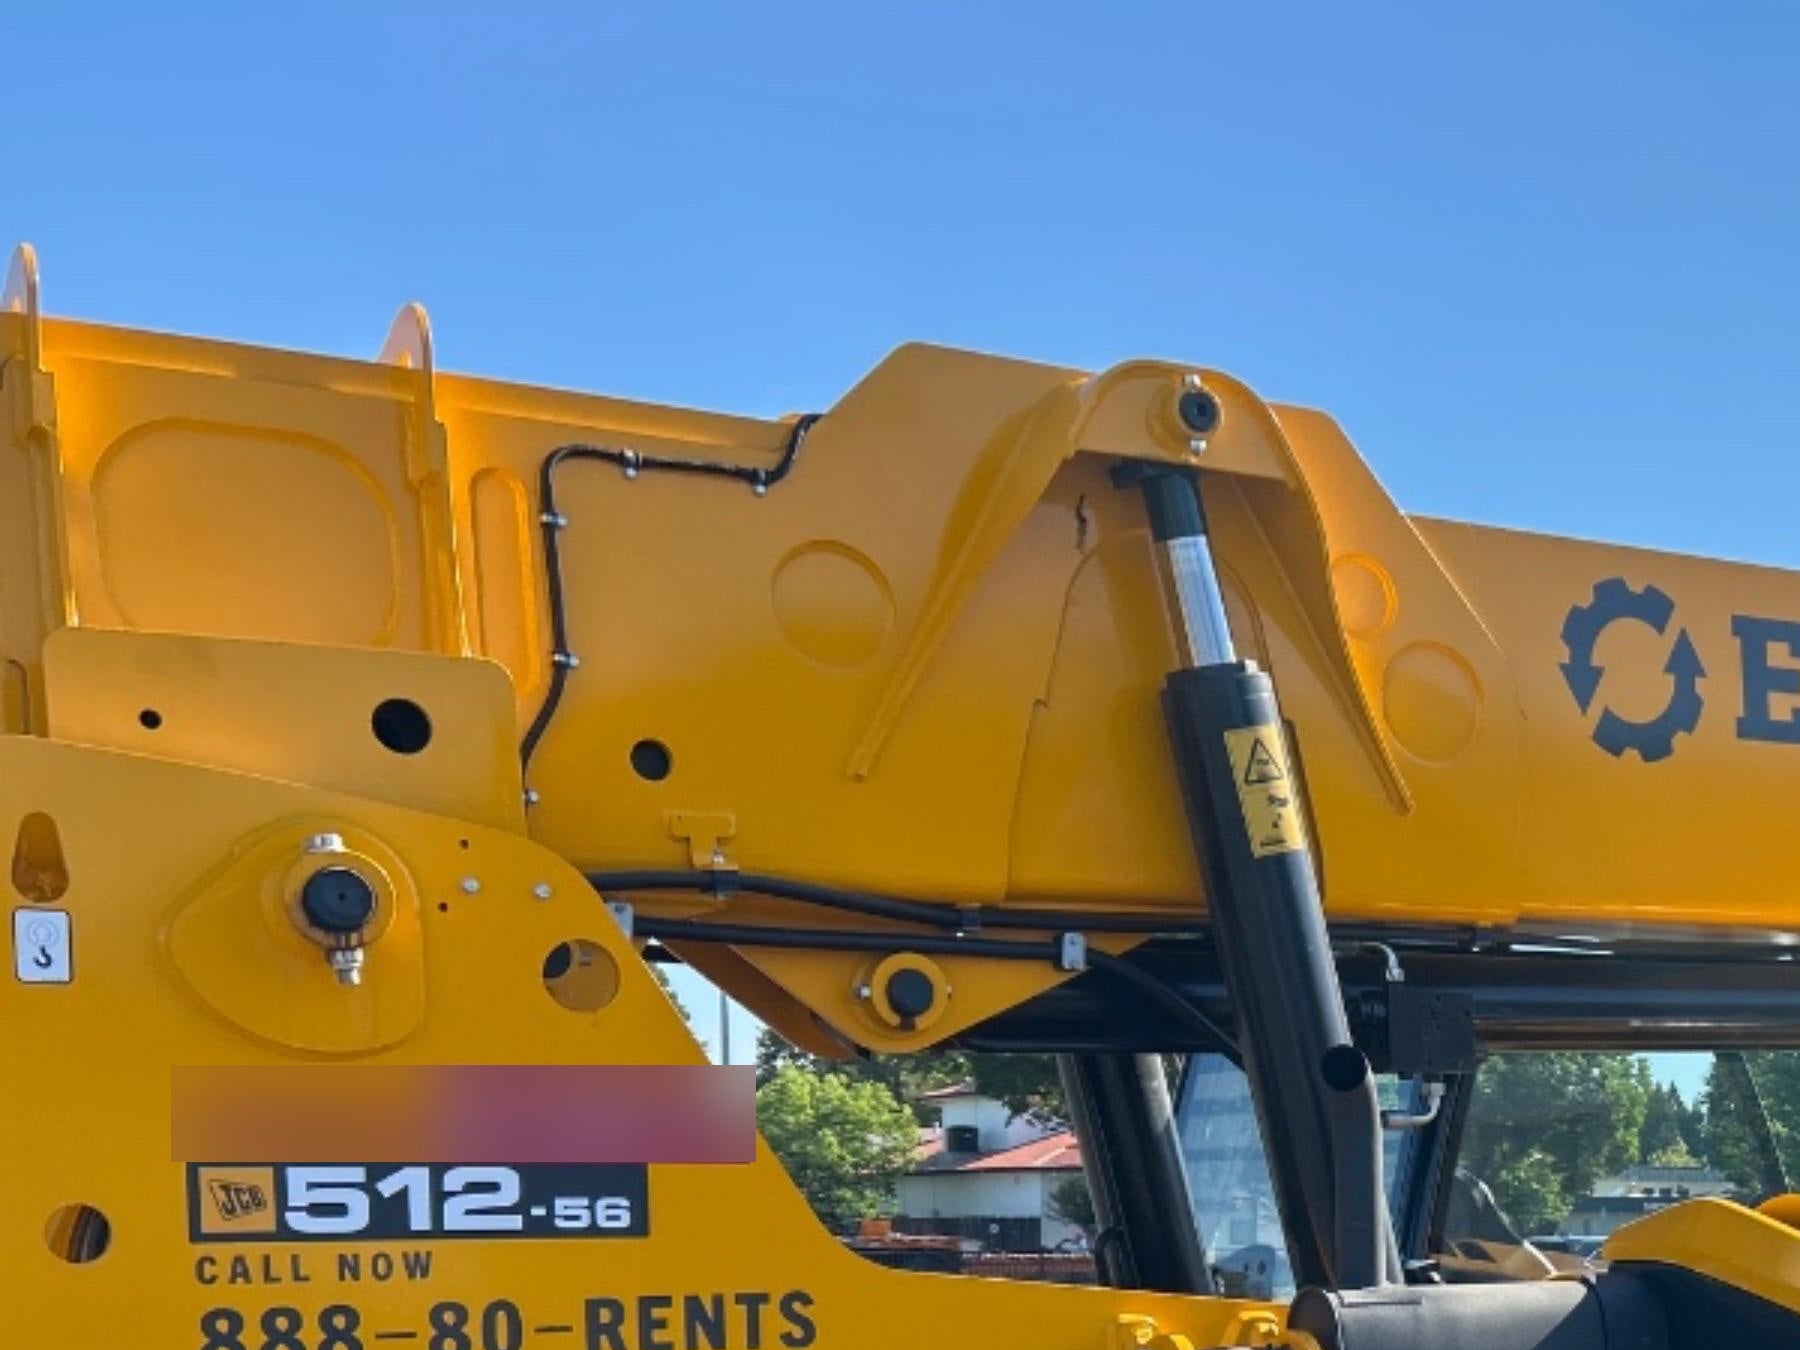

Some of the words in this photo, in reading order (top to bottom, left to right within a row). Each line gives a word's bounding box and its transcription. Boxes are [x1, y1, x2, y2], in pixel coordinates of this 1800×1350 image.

[284, 1166, 632, 1234] 512-56
[194, 1252, 313, 1285] CALL
[337, 1250, 434, 1282] NOW
